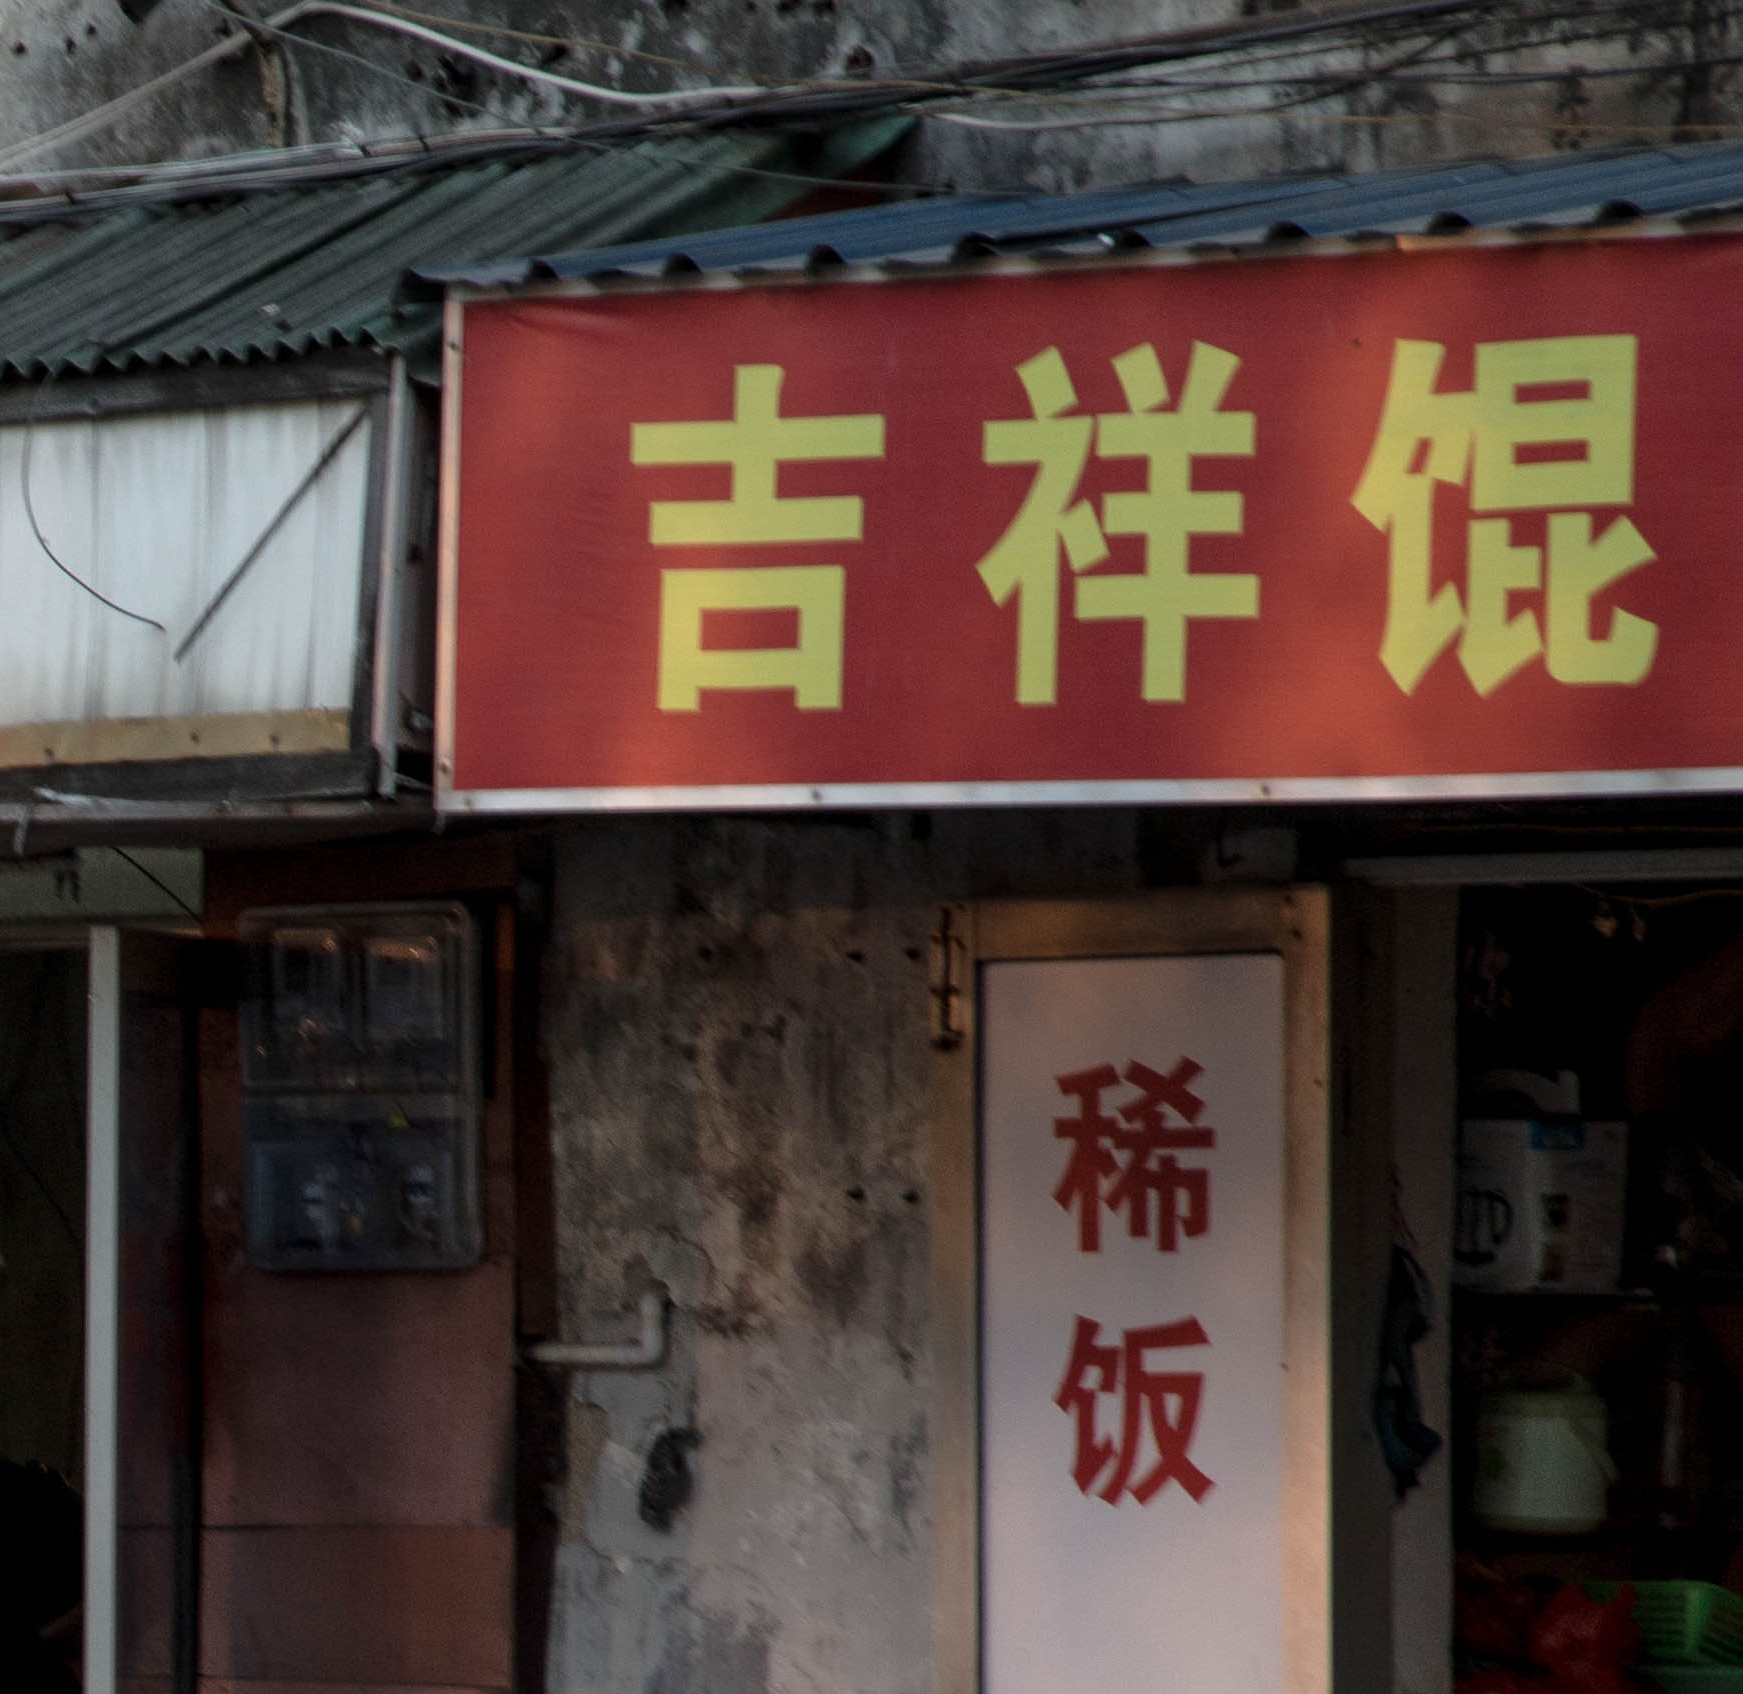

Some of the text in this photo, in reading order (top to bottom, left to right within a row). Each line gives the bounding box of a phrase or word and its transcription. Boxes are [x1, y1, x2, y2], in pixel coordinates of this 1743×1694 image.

[627, 333, 1659, 714] 吉祥馄
[1051, 1056, 1216, 1507] 稀饭
